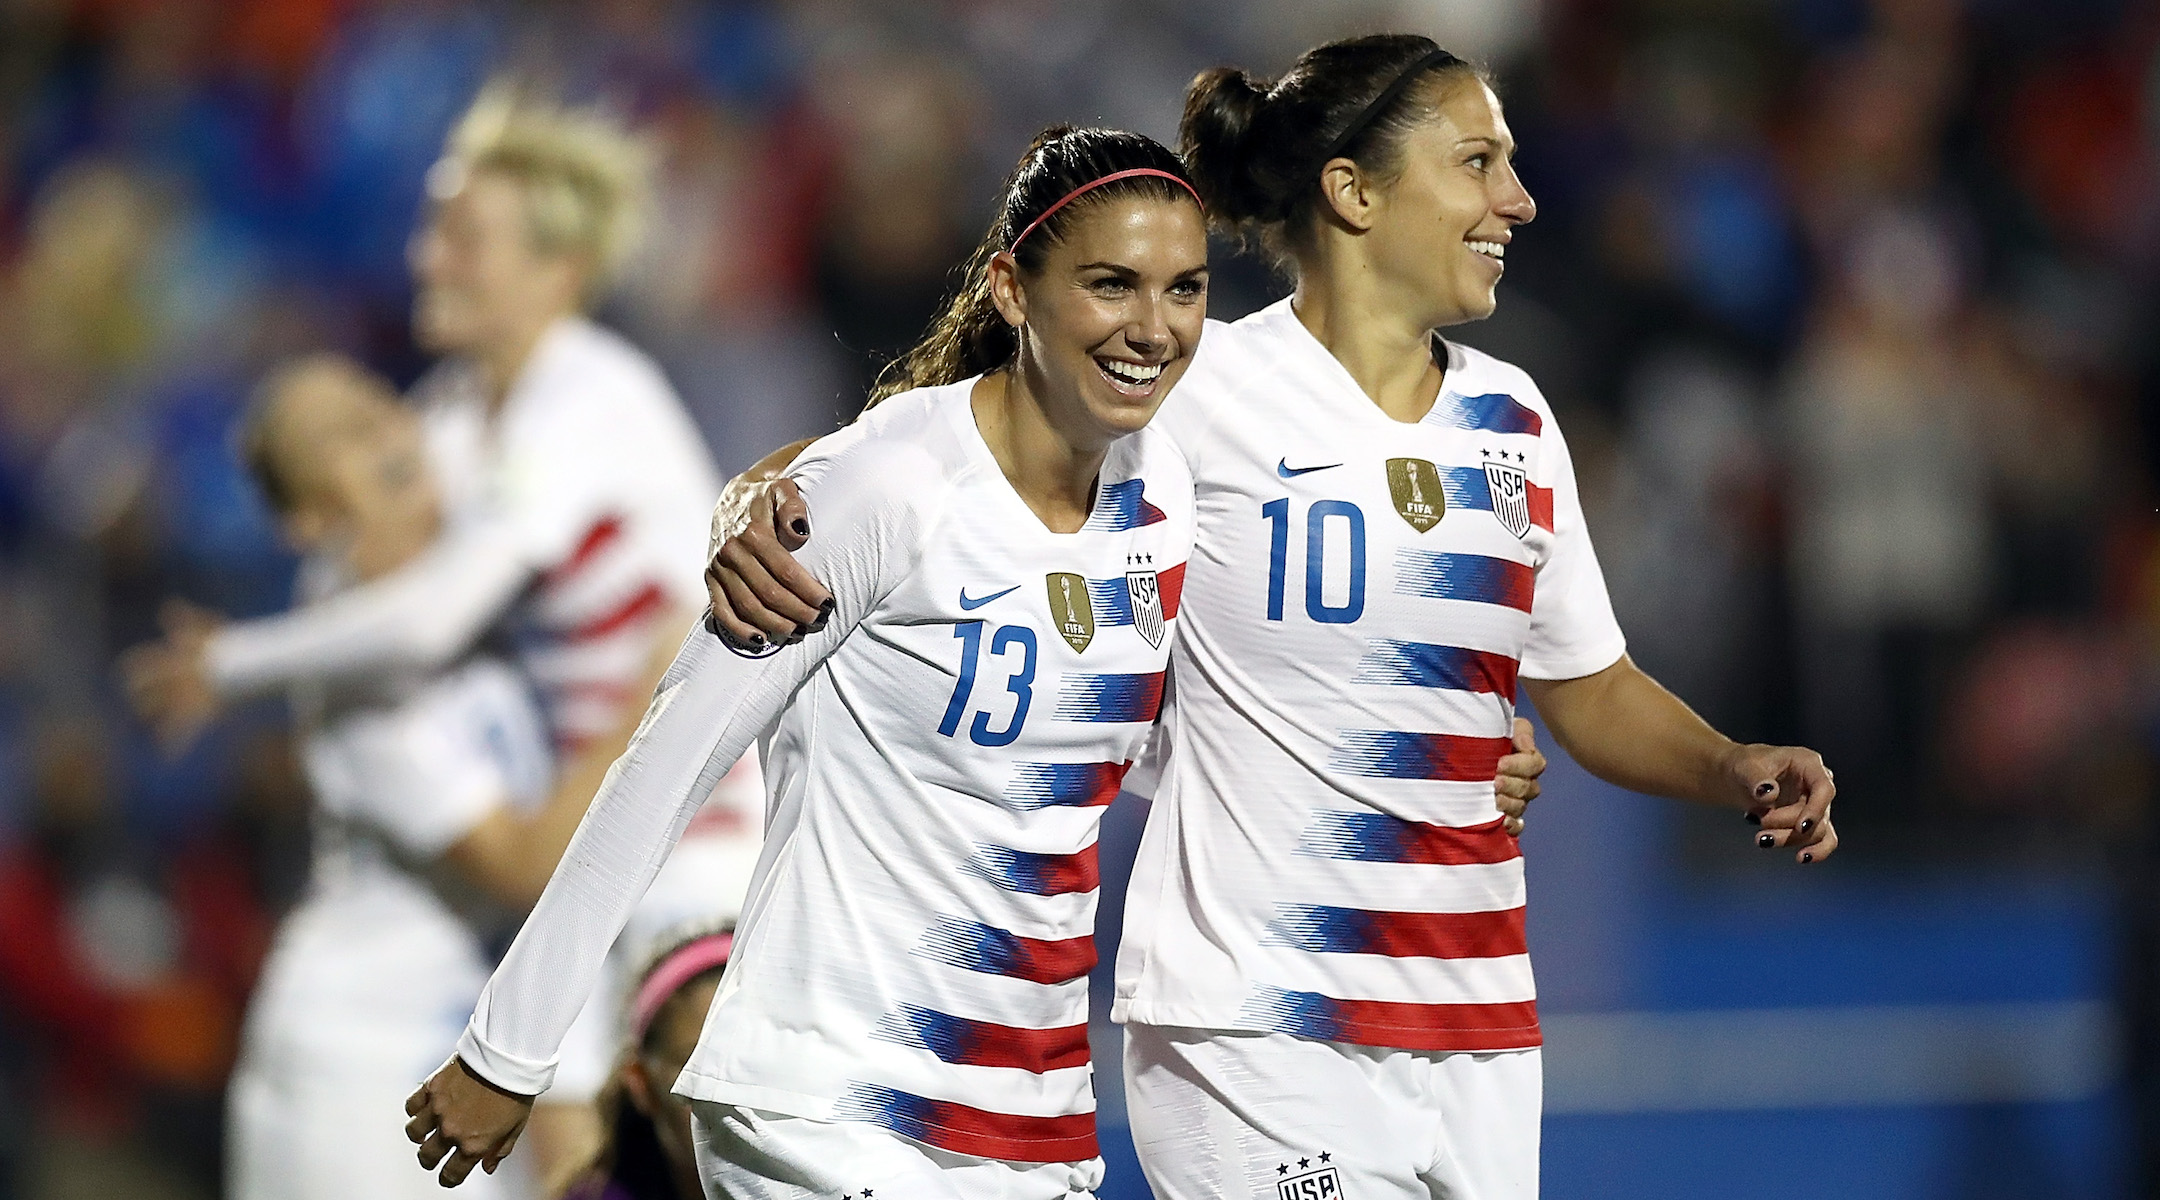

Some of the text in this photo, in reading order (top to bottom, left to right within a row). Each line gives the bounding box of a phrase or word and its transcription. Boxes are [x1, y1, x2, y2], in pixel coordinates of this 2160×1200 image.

[1489, 468, 1523, 497] USA
[1406, 502, 1433, 515] FIFA
[1262, 497, 1366, 624] 10
[1130, 576, 1156, 604] USA
[1064, 623, 1086, 635] FIFA
[936, 620, 1038, 747] 13
[1284, 1174, 1335, 1200] USA
